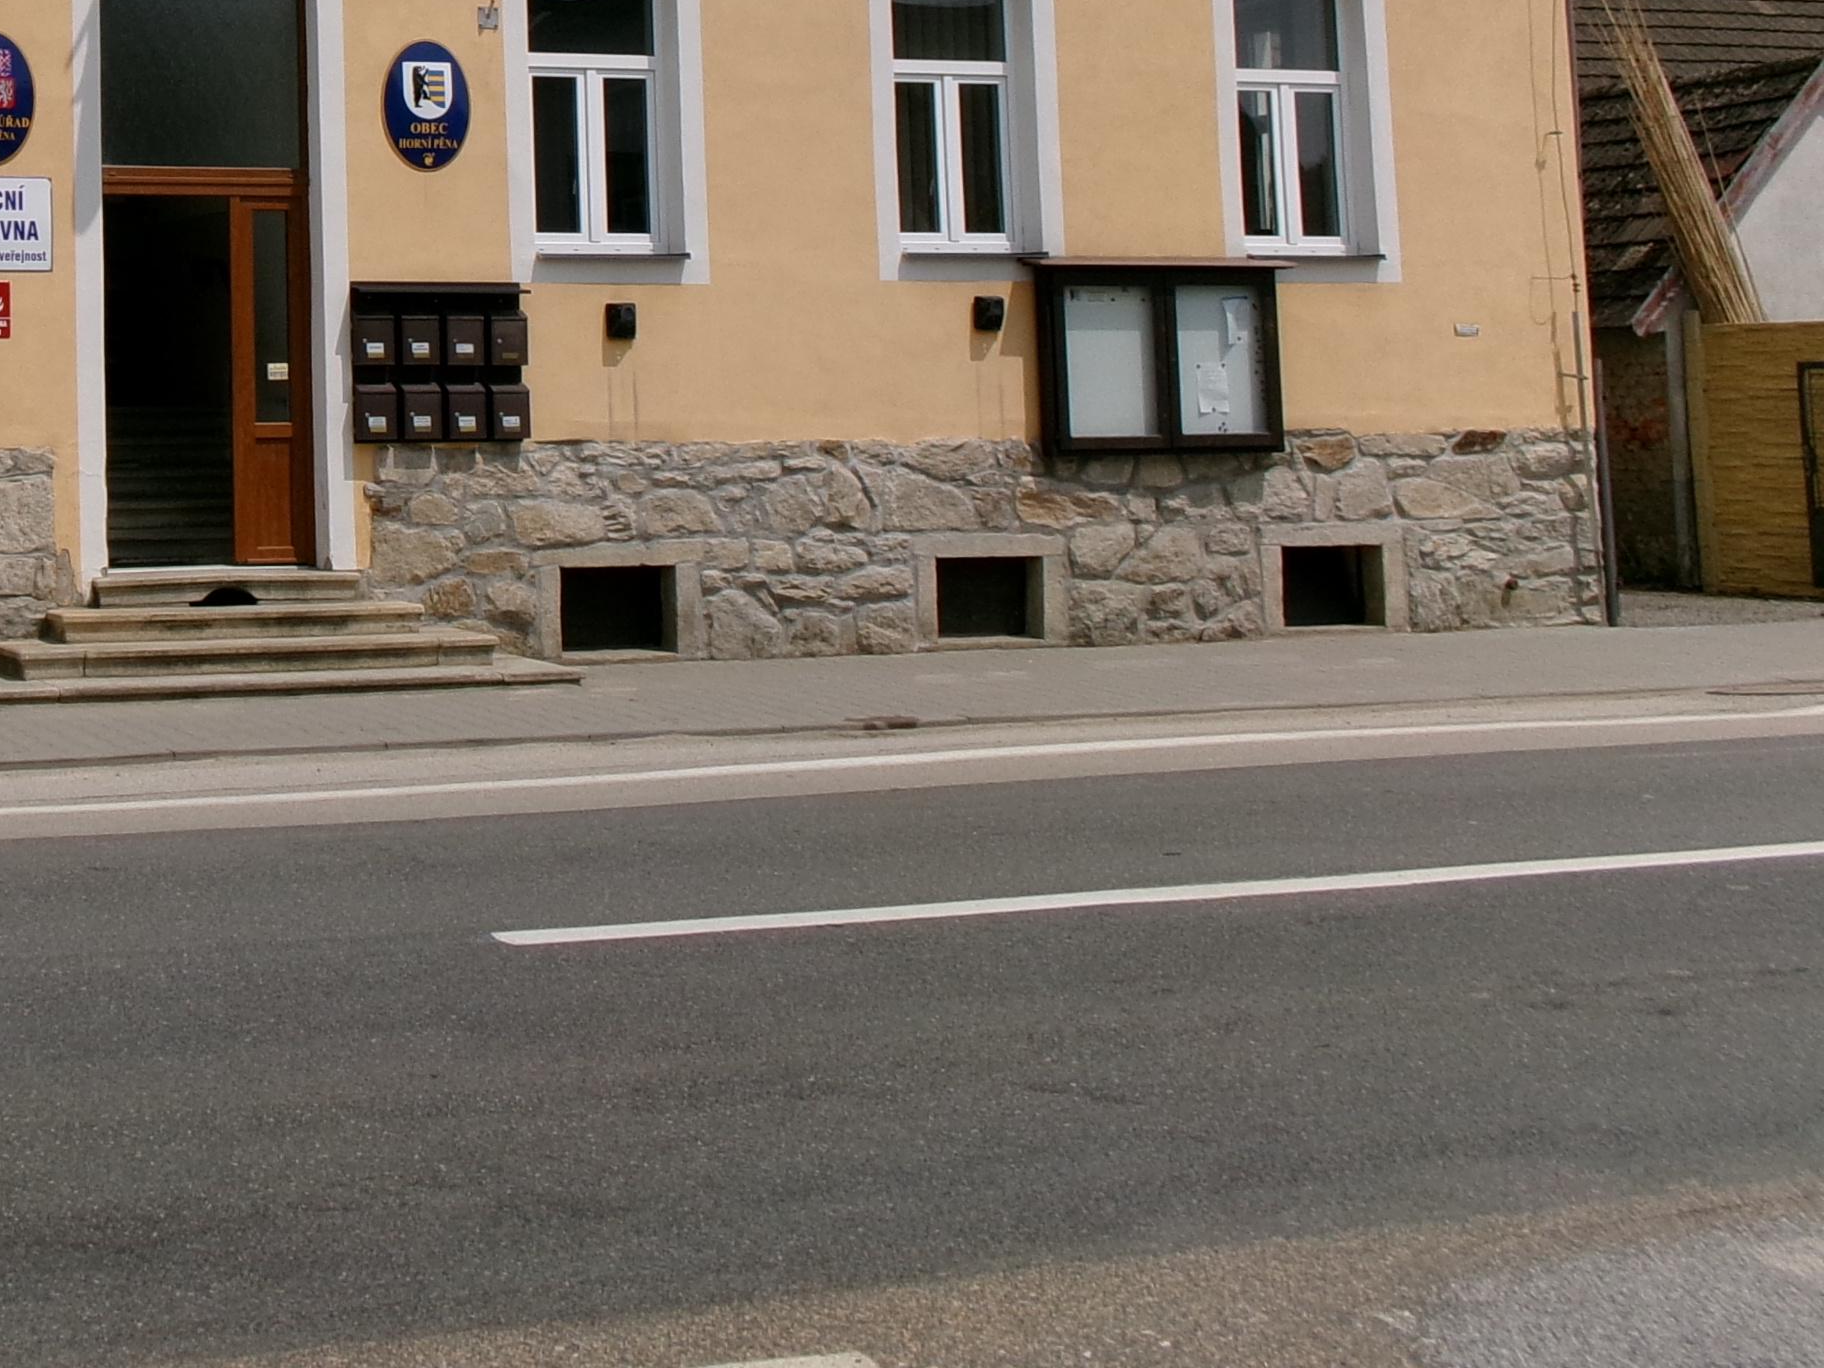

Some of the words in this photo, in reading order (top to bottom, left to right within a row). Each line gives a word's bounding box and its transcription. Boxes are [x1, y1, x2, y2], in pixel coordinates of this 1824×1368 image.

[410, 122, 448, 134] OBEC
[399, 136, 431, 149] HORNÍ
[433, 137, 458, 149] PĚNA
[0, 250, 47, 264] veřejnost
